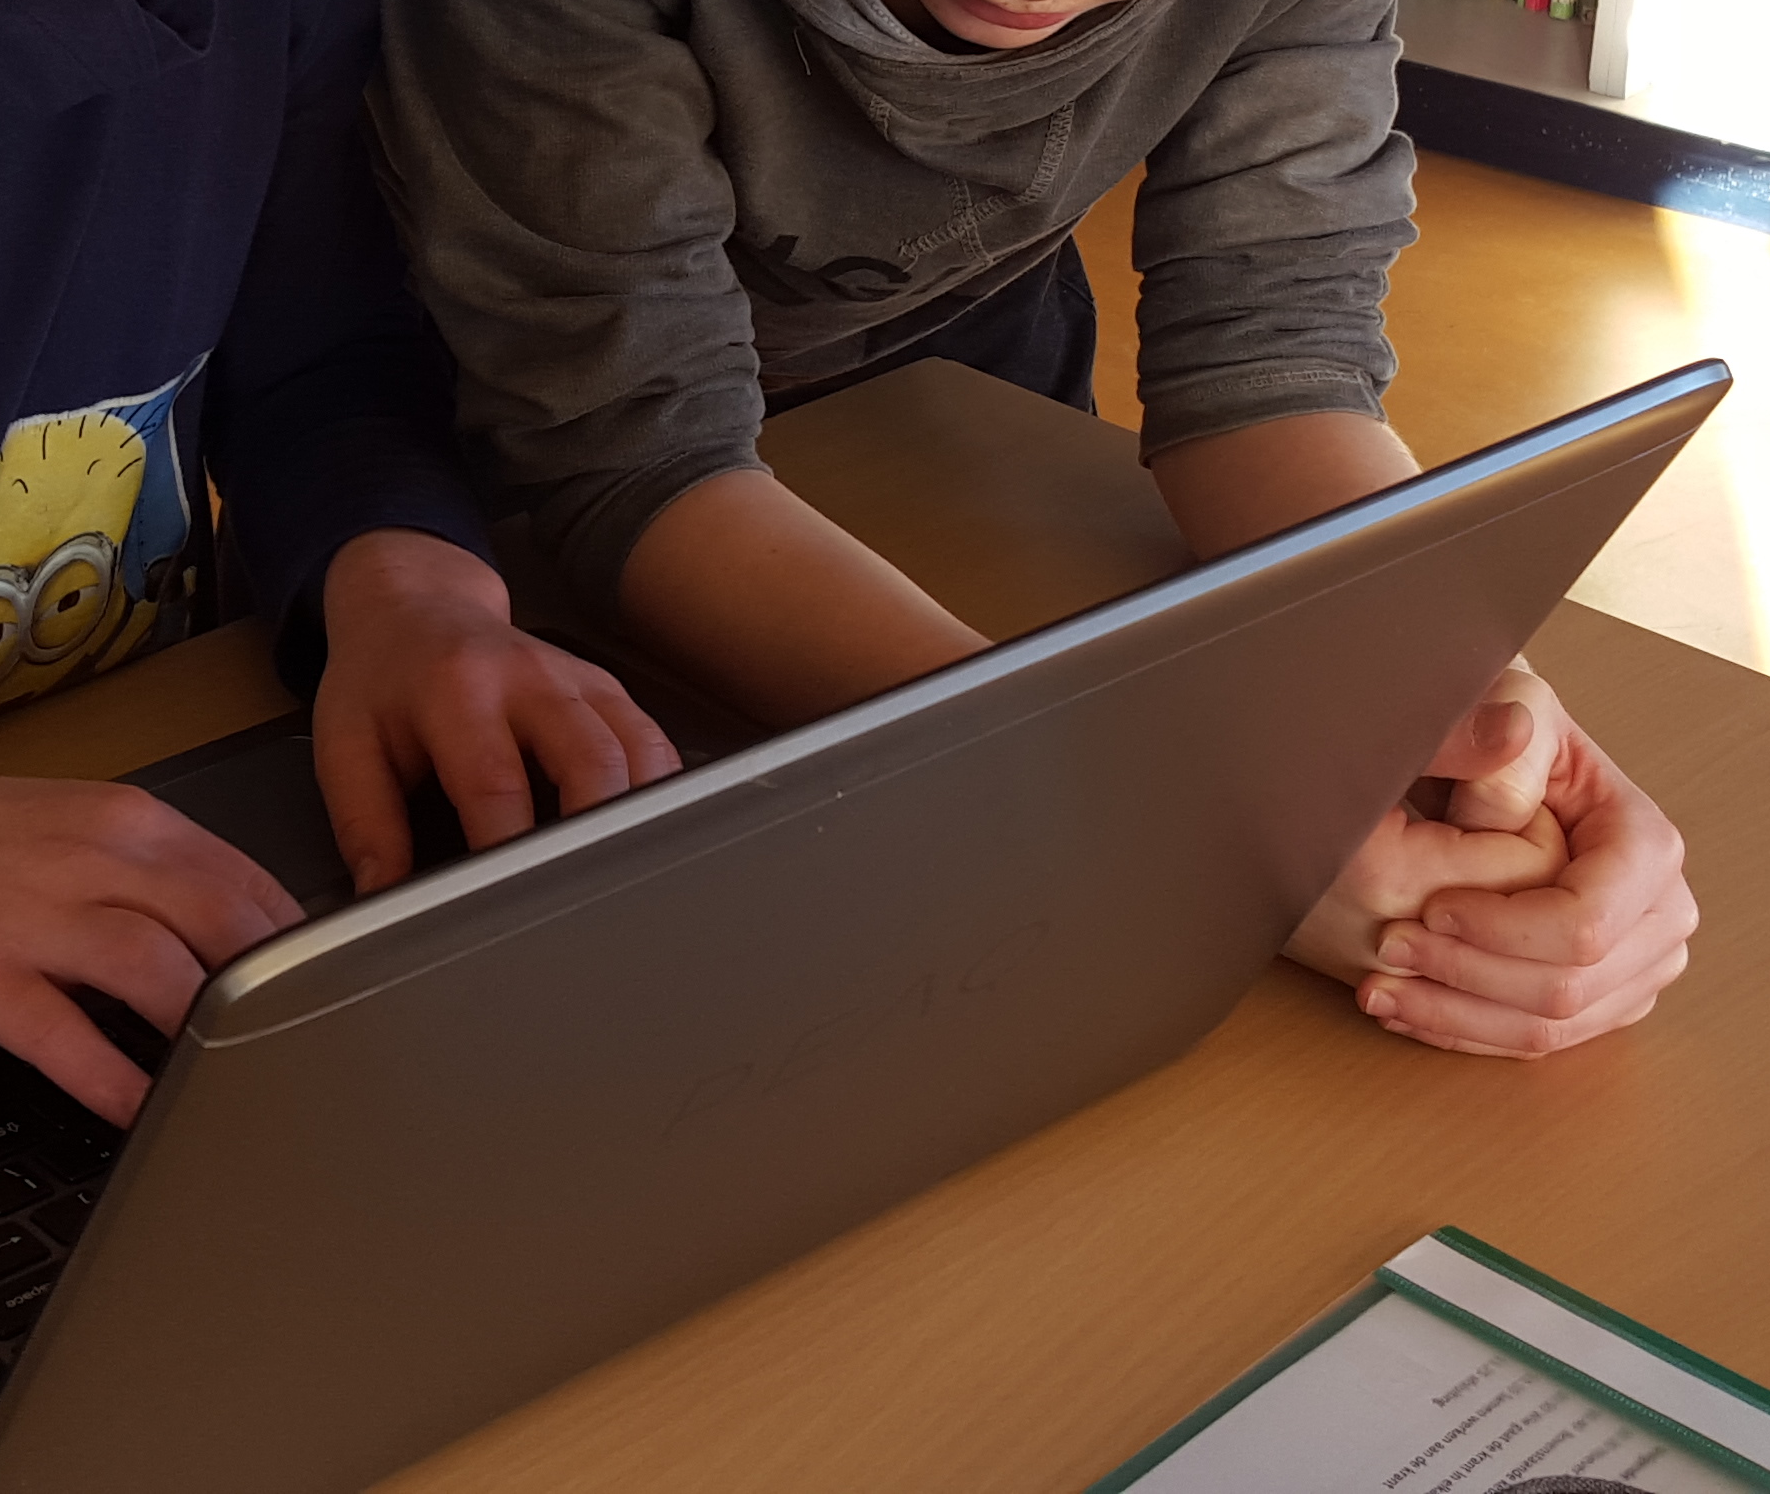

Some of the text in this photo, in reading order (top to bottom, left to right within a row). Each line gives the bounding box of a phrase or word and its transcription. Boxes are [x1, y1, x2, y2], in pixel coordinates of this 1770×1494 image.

[1443, 1415, 1480, 1444] werken
[1424, 1442, 1441, 1460] aan
[1487, 1439, 1503, 1455] de
[1411, 1455, 1427, 1472] de
[1462, 1453, 1490, 1474] krant
[1383, 1467, 1410, 1489] krant
